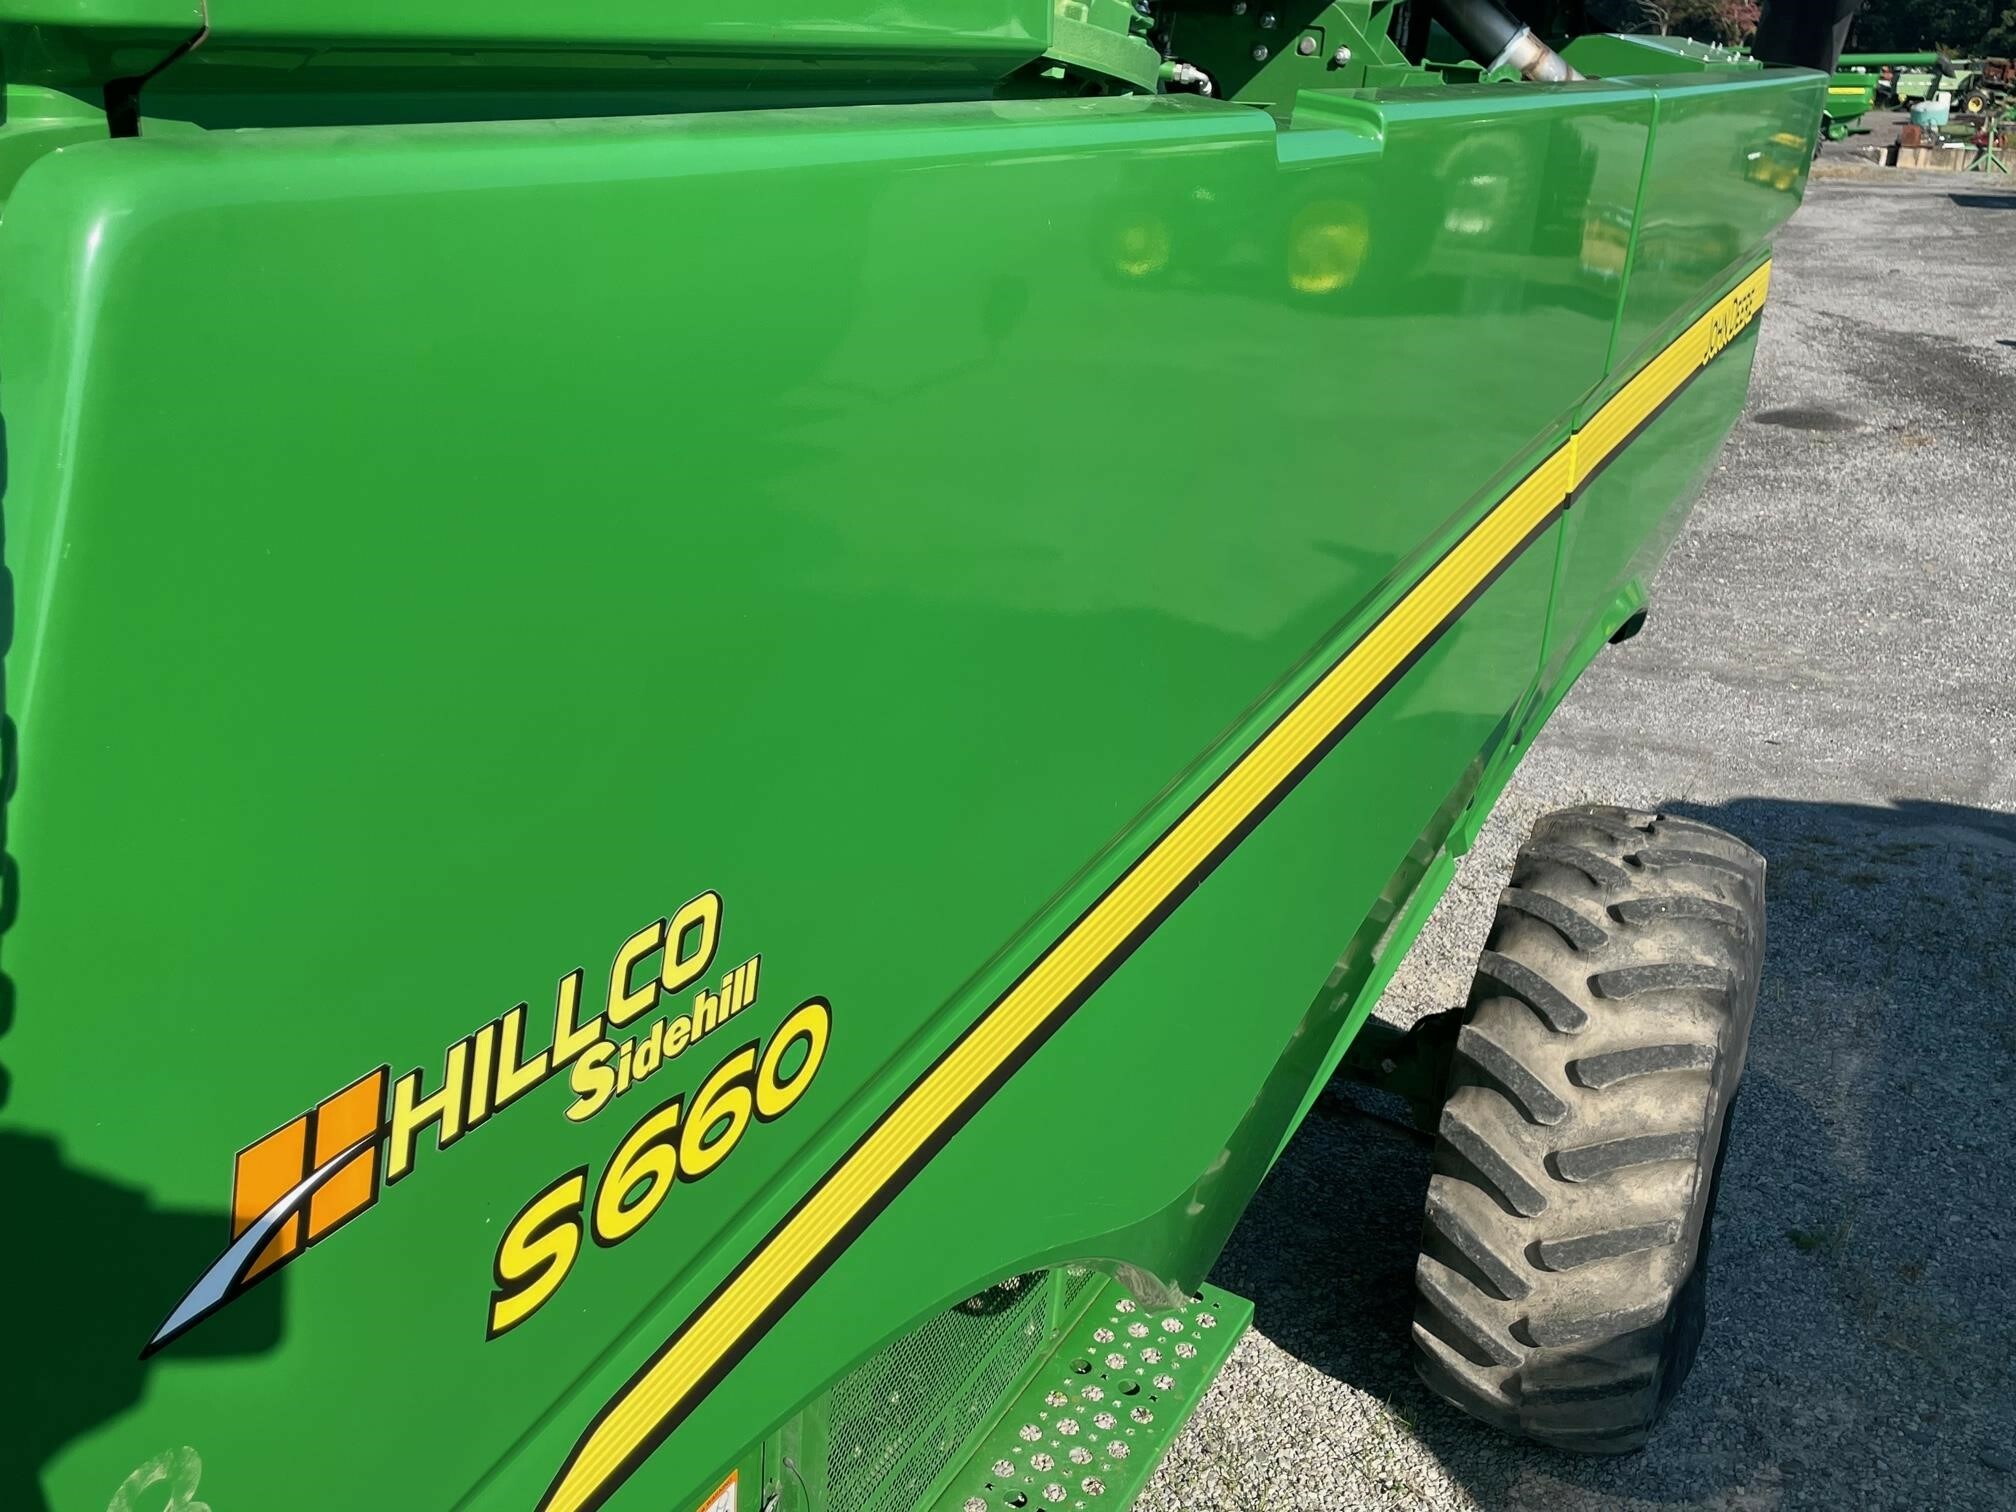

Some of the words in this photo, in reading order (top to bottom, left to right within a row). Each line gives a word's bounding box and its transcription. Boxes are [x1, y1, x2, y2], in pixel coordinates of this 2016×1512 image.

[386, 890, 722, 1184] HILLCO
[487, 998, 831, 1340] S660
[565, 954, 760, 1121] Sidehill
